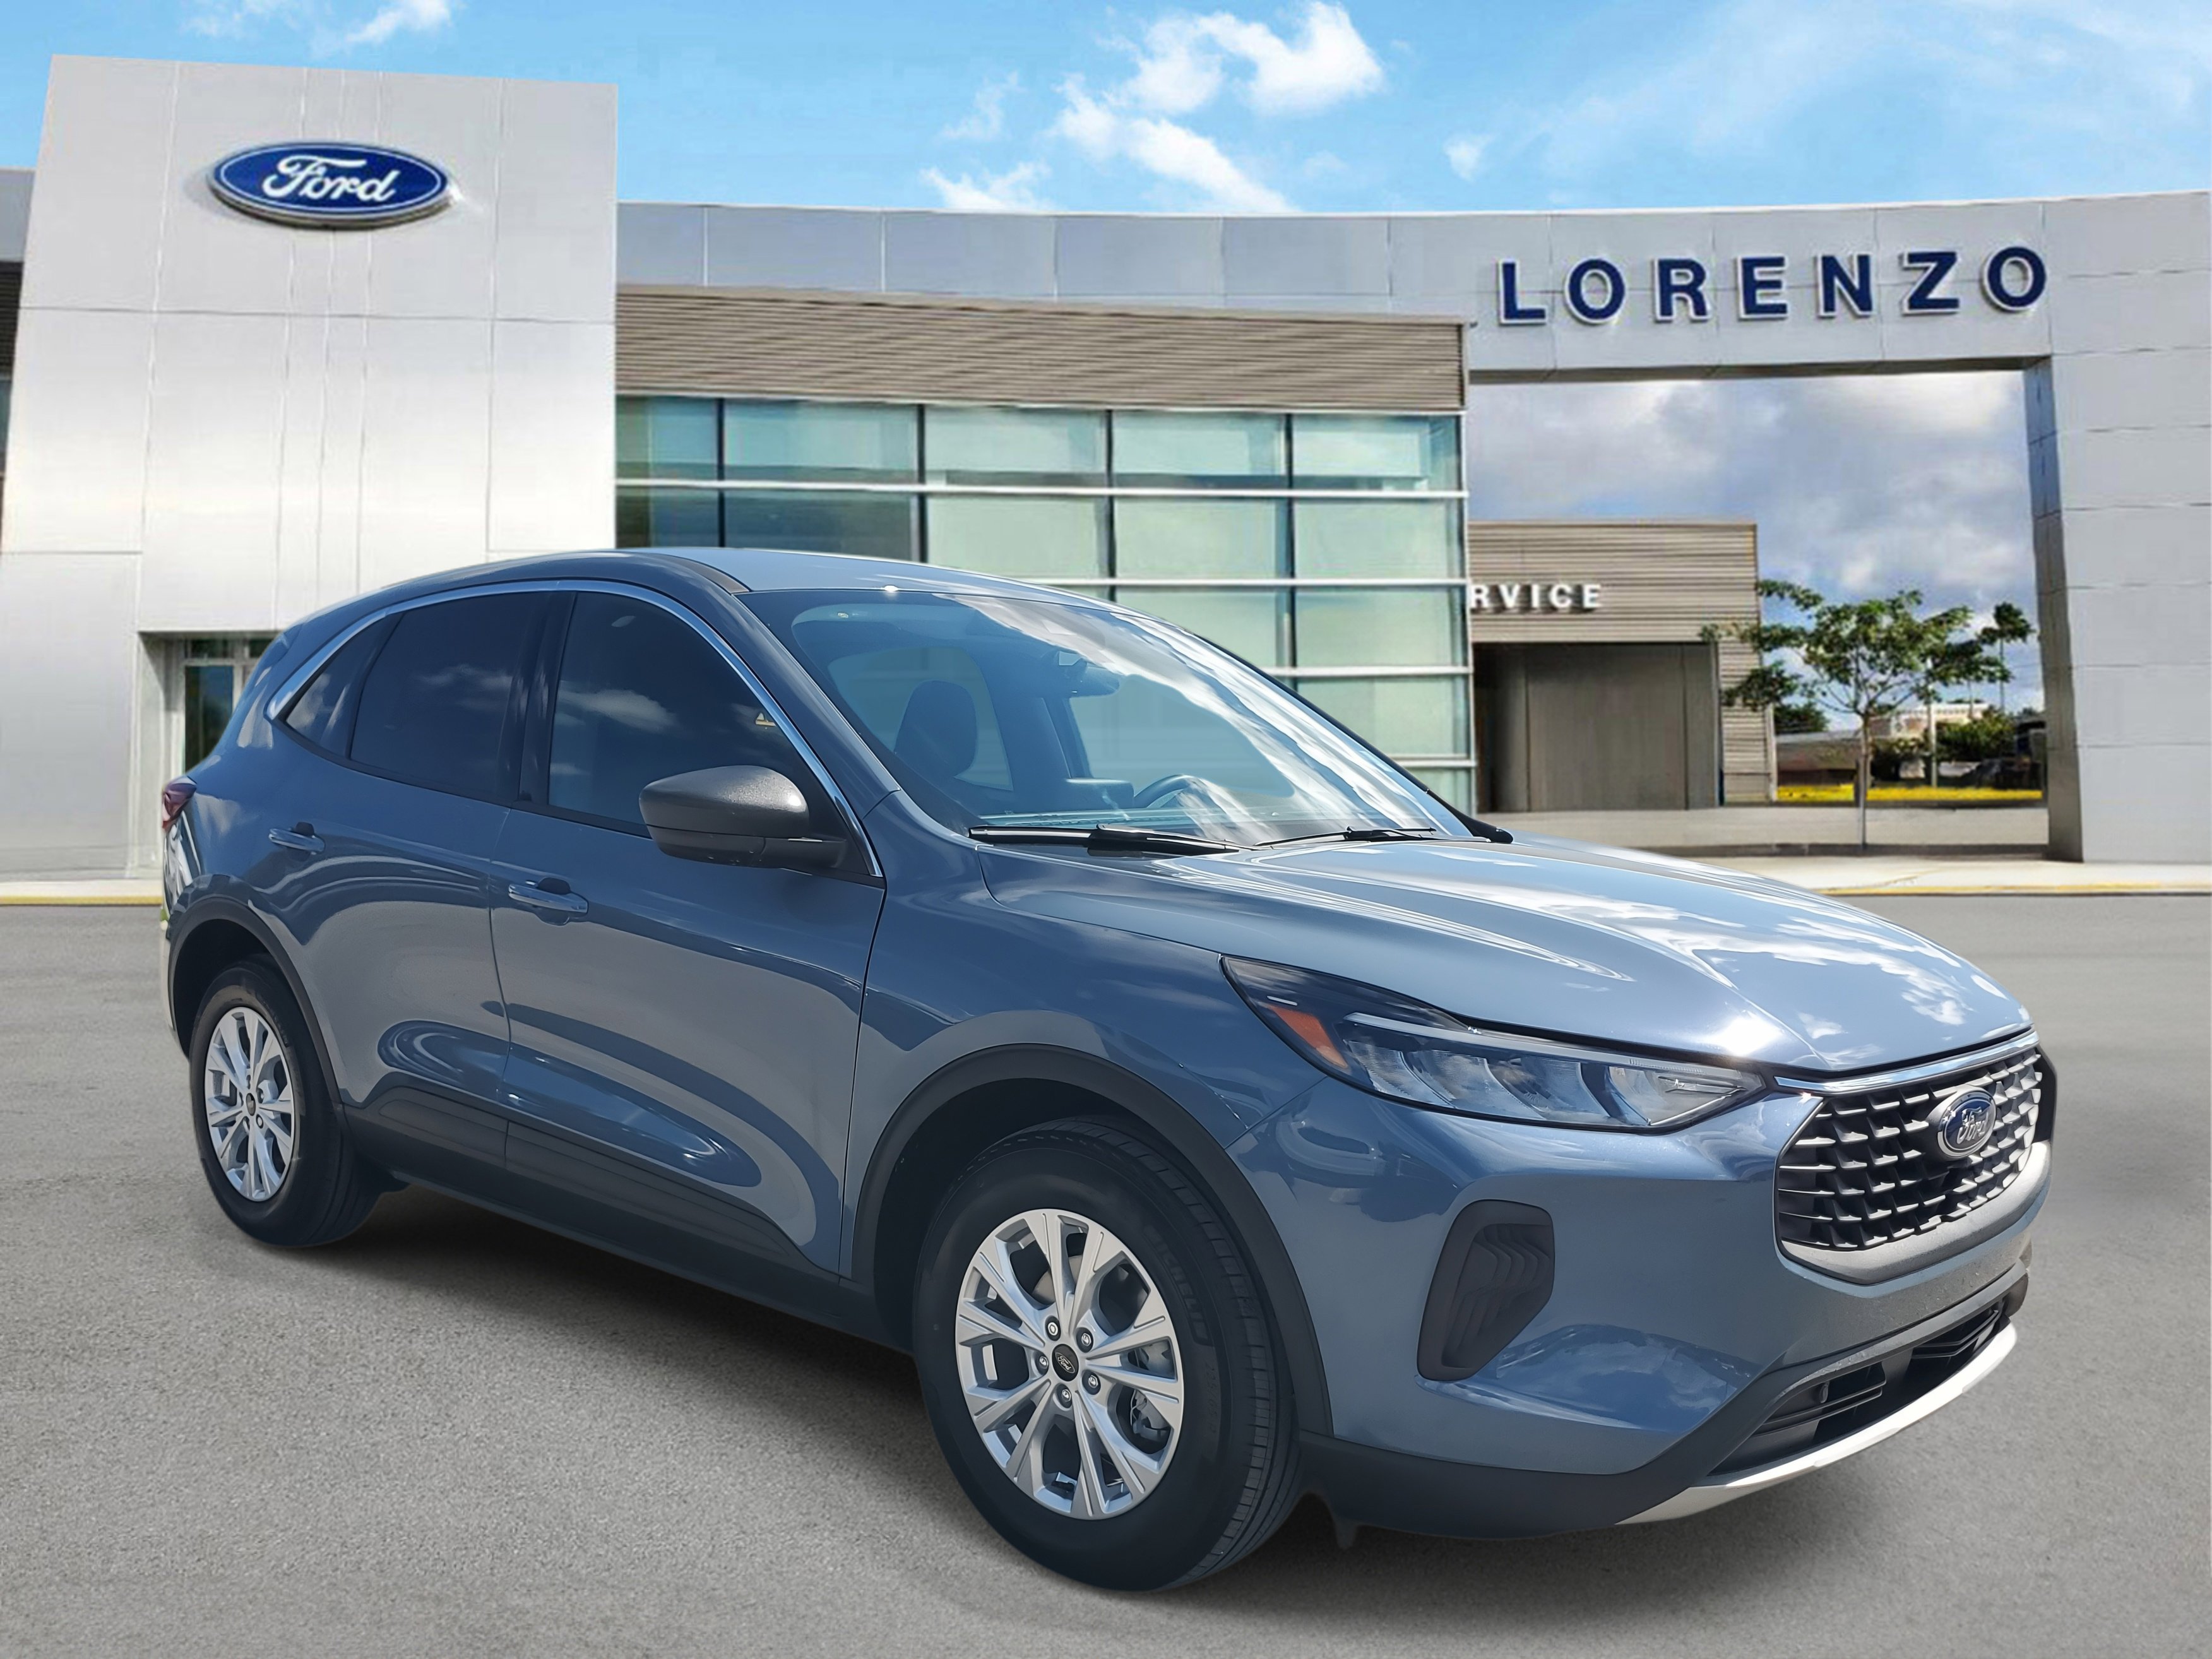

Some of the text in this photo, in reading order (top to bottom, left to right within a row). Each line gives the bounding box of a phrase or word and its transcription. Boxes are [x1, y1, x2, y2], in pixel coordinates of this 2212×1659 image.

[263, 155, 400, 201] Ford
[1498, 246, 2047, 324] LORENZO
[1957, 1106, 1989, 1145] Ford
[1058, 1356, 1072, 1371] Ford
